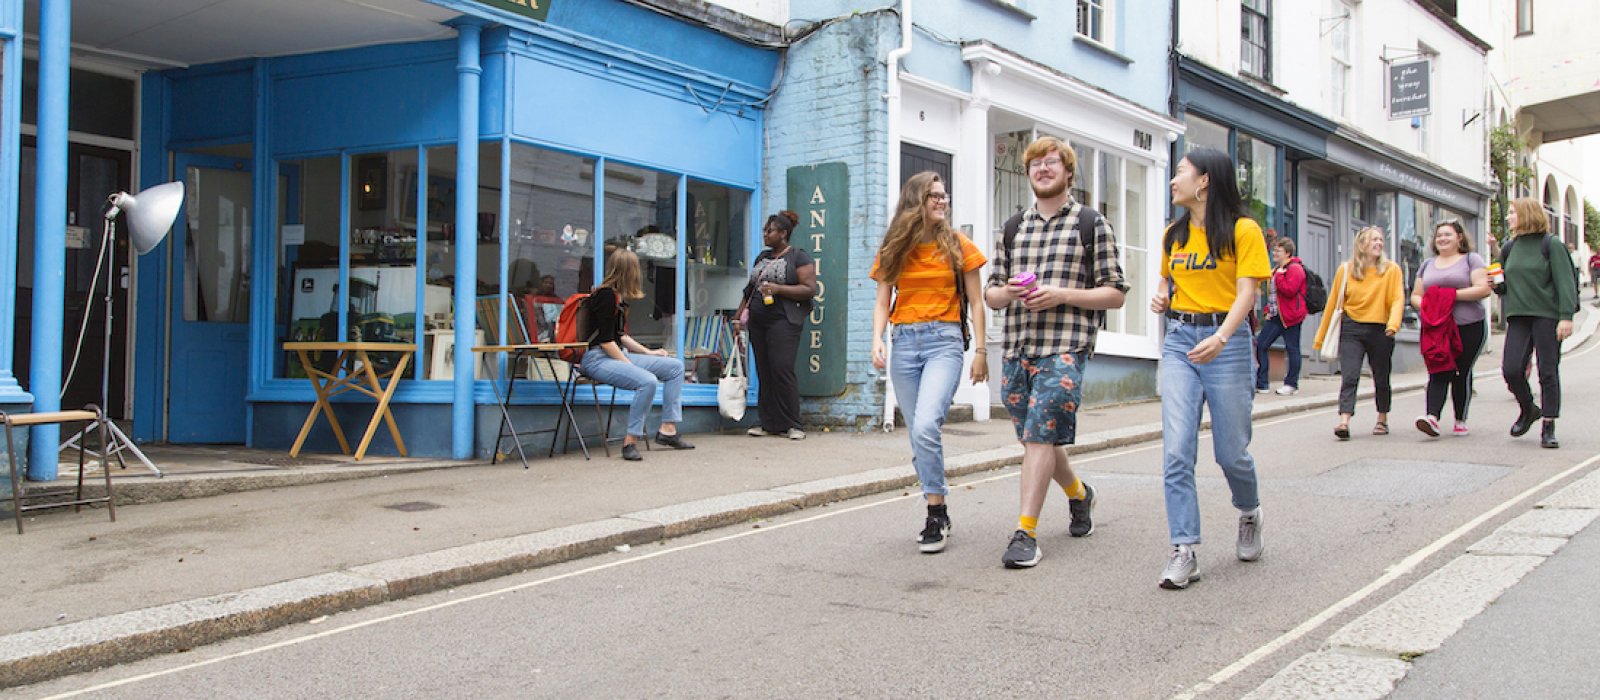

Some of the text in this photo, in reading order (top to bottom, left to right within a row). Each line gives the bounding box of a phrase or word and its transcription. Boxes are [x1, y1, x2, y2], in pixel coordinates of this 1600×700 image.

[919, 110, 925, 121] 6
[1171, 252, 1217, 270] FILA
[809, 184, 826, 374] ANTIQUES
